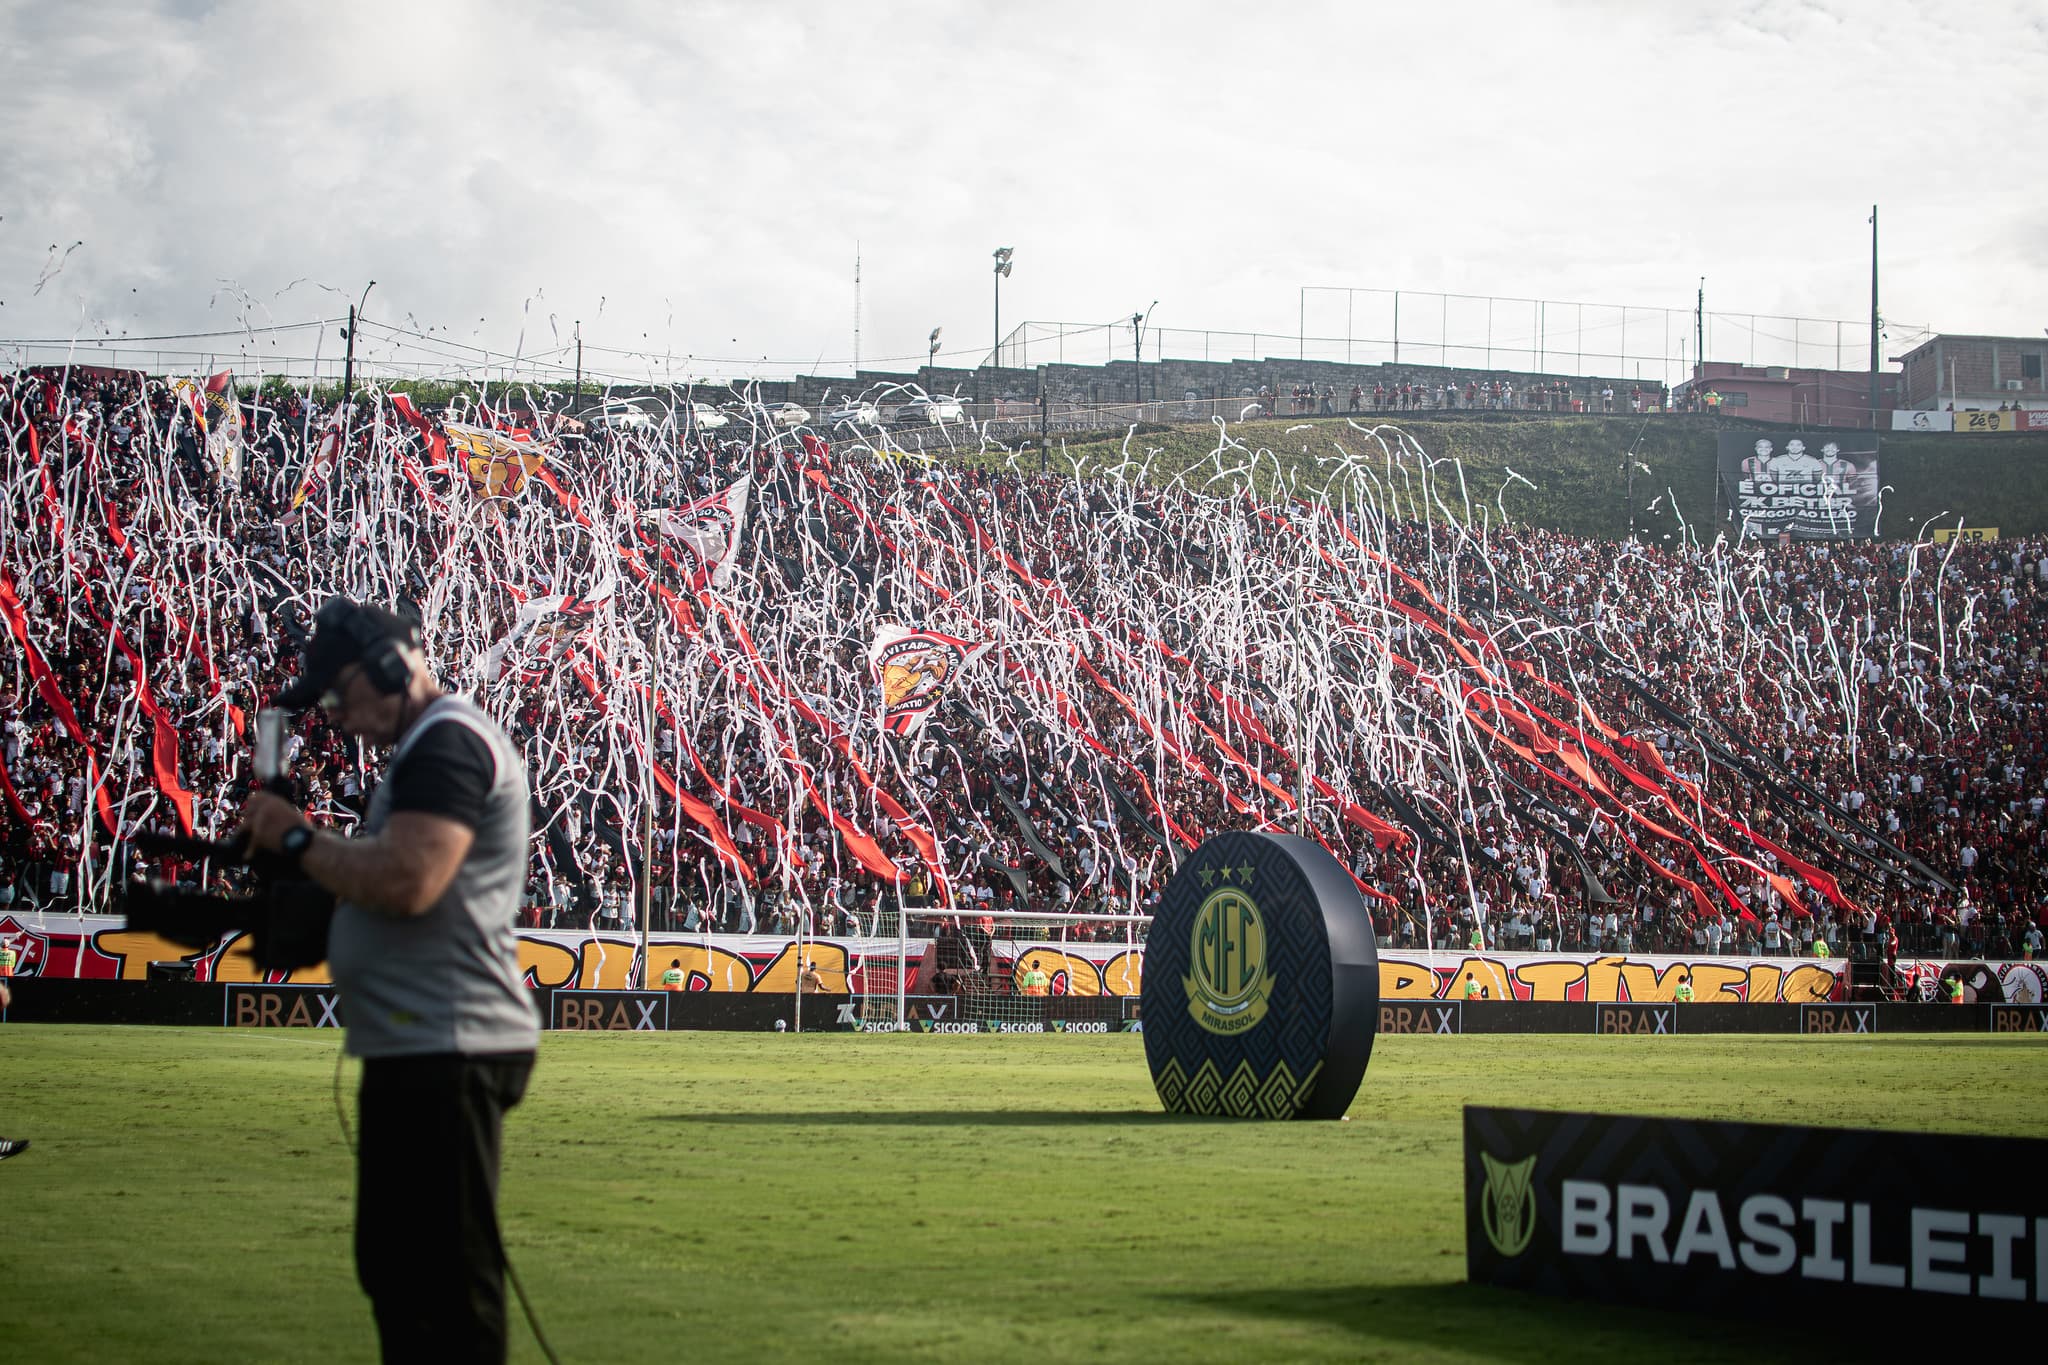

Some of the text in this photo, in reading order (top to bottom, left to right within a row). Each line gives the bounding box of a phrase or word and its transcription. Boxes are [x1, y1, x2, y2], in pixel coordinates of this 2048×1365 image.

[1760, 482, 1857, 496] OFICIAL
[1739, 495, 1769, 508] 7K
[1740, 508, 1795, 518] CHEGOU
[1798, 509, 1818, 518] AO
[1198, 898, 1256, 996] MFC
[236, 993, 341, 1027] BRAX
[561, 999, 659, 1031] BRAX
[1201, 1010, 1256, 1032] MIRASSOL
[1380, 1007, 1453, 1034] BRAX
[933, 1022, 978, 1033] SICOOB
[1000, 1022, 1044, 1033] SICOOB
[1065, 1022, 1108, 1033] SICOOB
[1603, 1009, 1670, 1034] BRAX
[1807, 1010, 1870, 1034] BRAX
